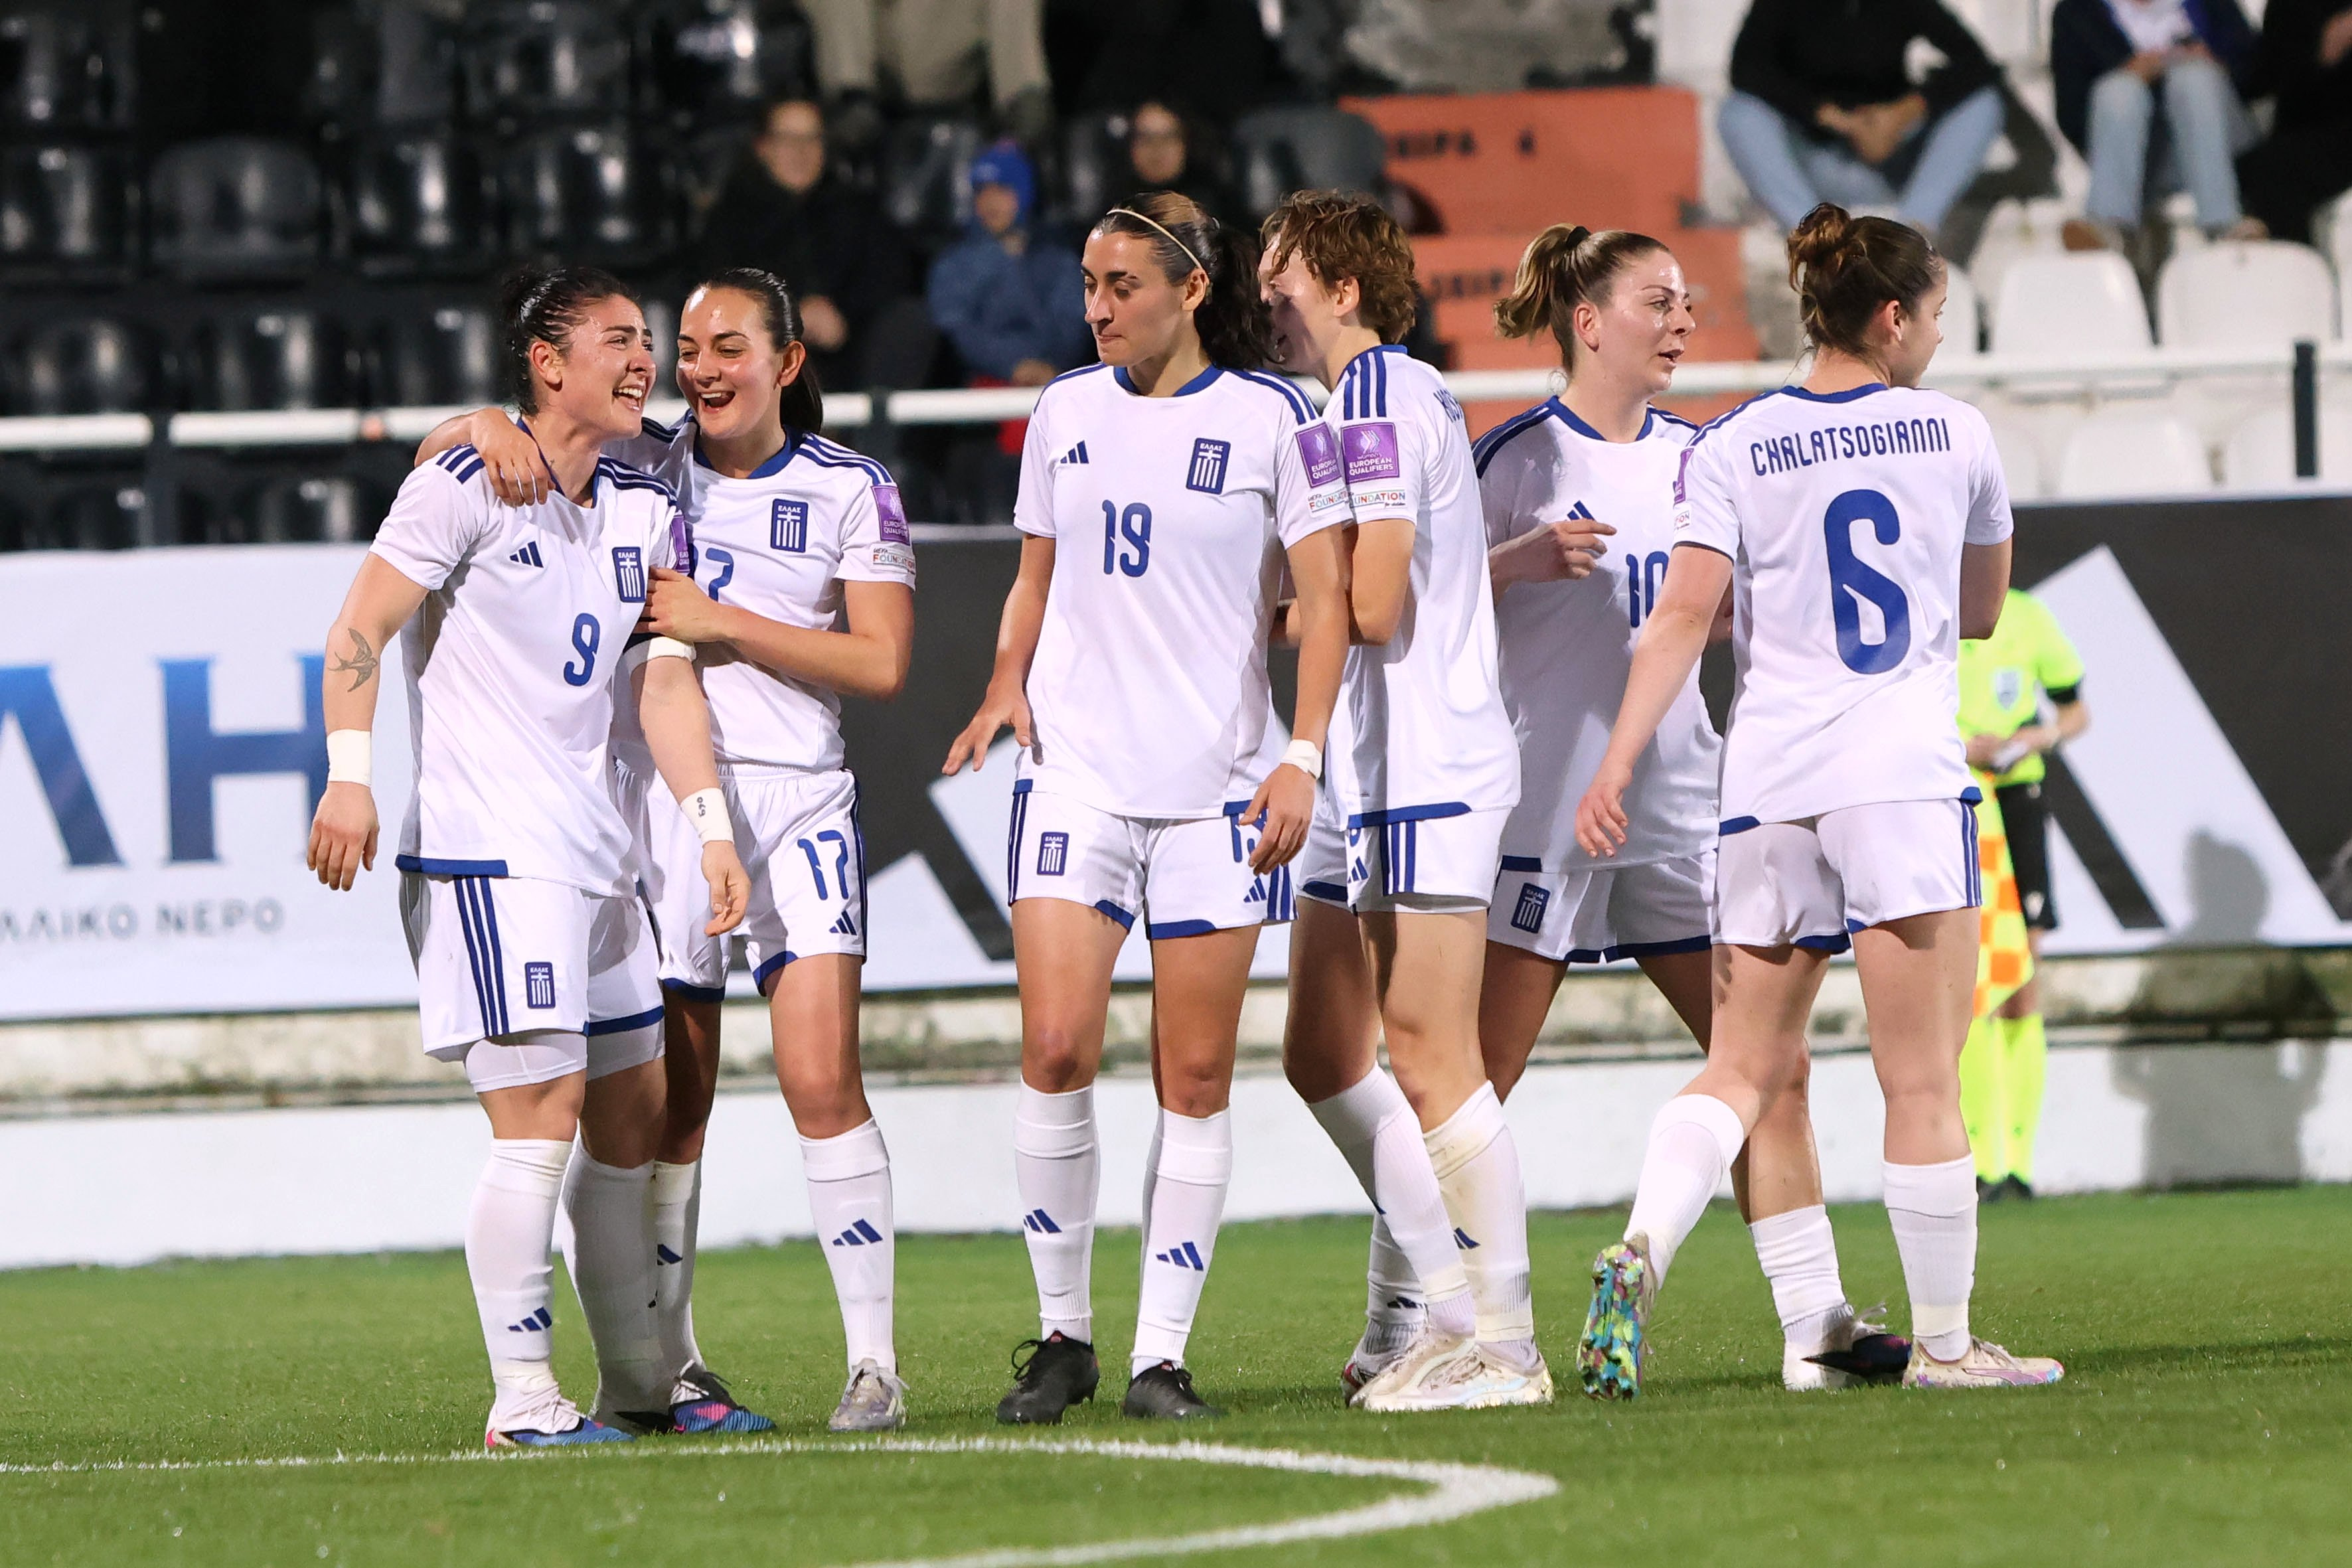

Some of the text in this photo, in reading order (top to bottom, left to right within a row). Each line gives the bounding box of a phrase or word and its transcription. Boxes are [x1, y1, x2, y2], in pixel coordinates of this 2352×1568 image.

[1349, 457, 1392, 469] EUROPEAN
[1349, 464, 1394, 476] QUALIFIERS
[1750, 418, 1950, 477] CHALATSOGIANNI
[1352, 492, 1405, 505] UNDATION
[1102, 499, 1152, 578] 19
[692, 543, 735, 602] 7
[1626, 551, 1670, 628] 10
[1824, 489, 1911, 675] 6
[563, 612, 600, 687] 9
[797, 830, 849, 900] 17
